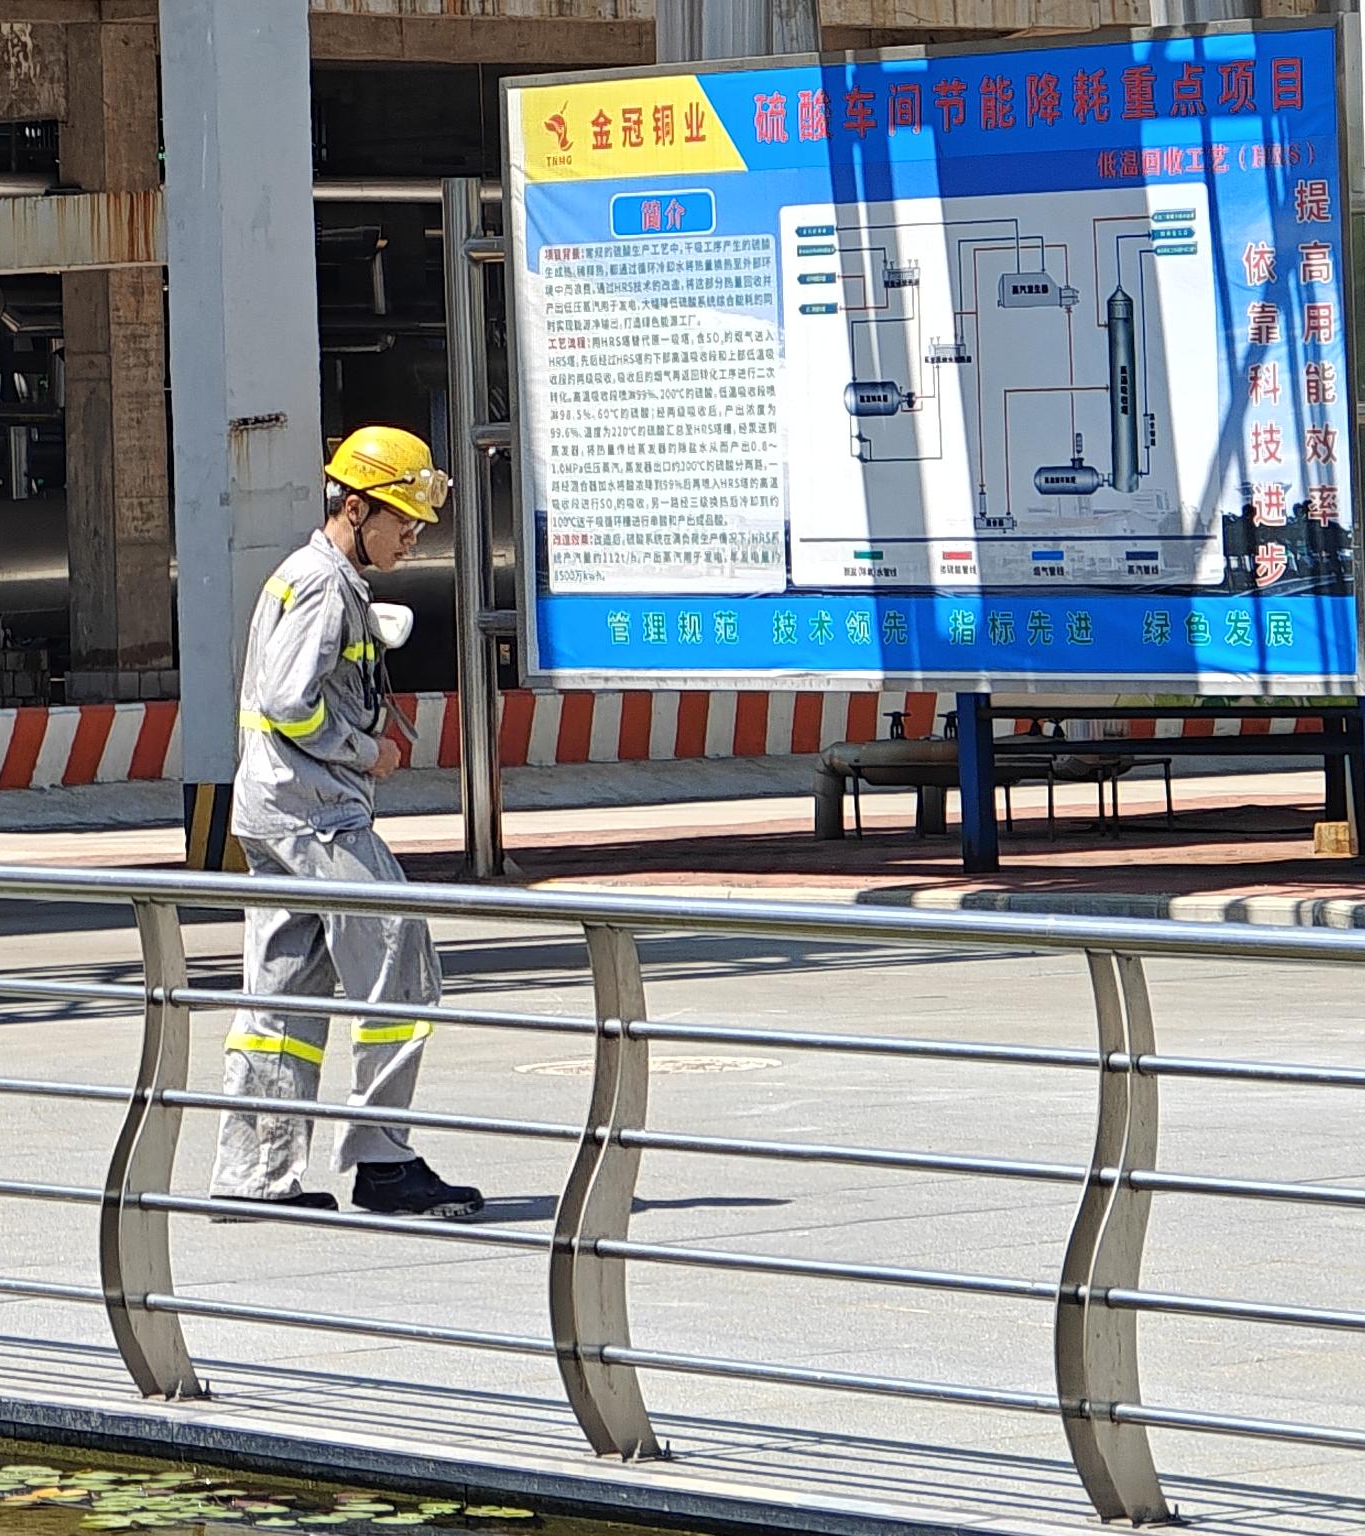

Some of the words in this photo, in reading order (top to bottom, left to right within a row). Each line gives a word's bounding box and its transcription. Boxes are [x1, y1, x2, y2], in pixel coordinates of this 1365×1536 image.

[591, 101, 707, 150] 金冠铜业
[753, 56, 1305, 144] 硫酸车间节能降耗重点项目
[641, 197, 686, 232] 简介
[1295, 178, 1340, 528] 提高用能效率
[1242, 240, 1288, 588] 依靠科技进步
[607, 610, 741, 645] 管理规范
[772, 610, 908, 645] 技术领先
[949, 610, 1095, 645] 指标先进
[1143, 610, 1294, 647] 绿色发展
